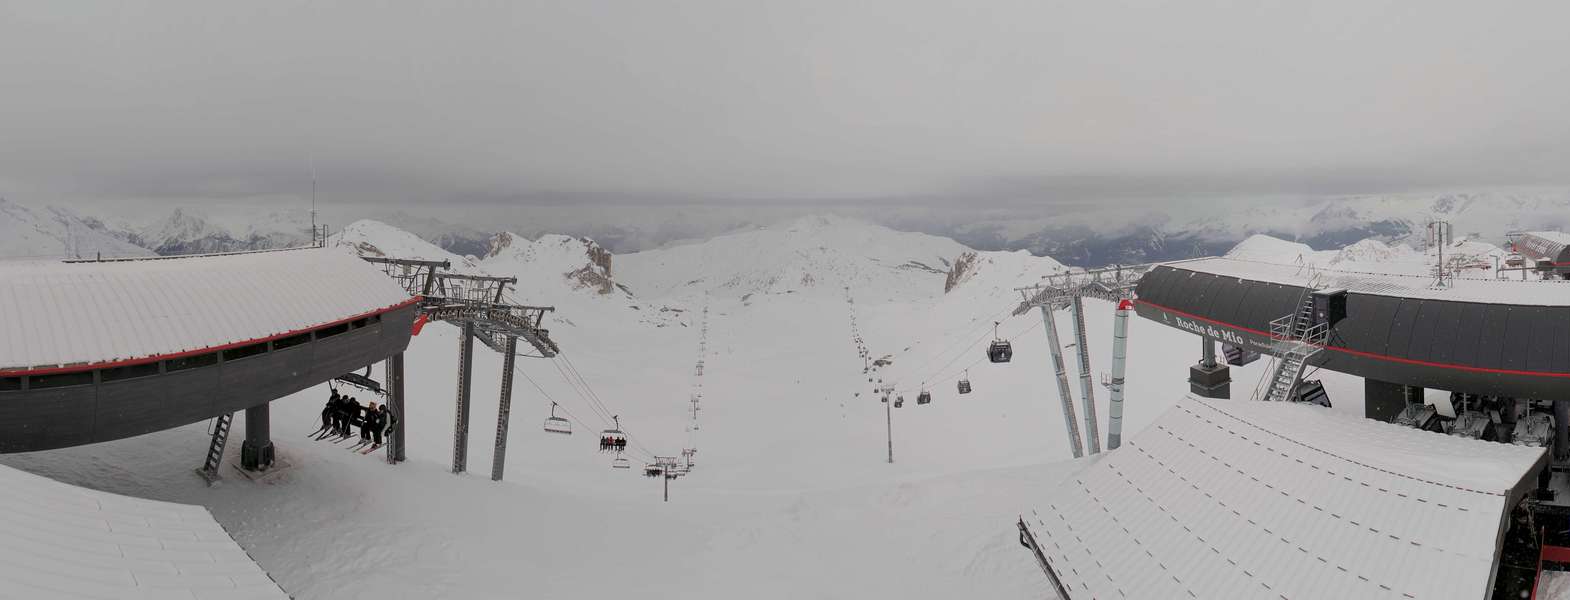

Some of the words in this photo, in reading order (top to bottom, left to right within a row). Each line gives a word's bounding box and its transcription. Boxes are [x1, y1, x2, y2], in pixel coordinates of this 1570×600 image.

[1175, 316, 1206, 334] Roche
[1207, 325, 1220, 338] de
[1221, 329, 1244, 345] Mio
